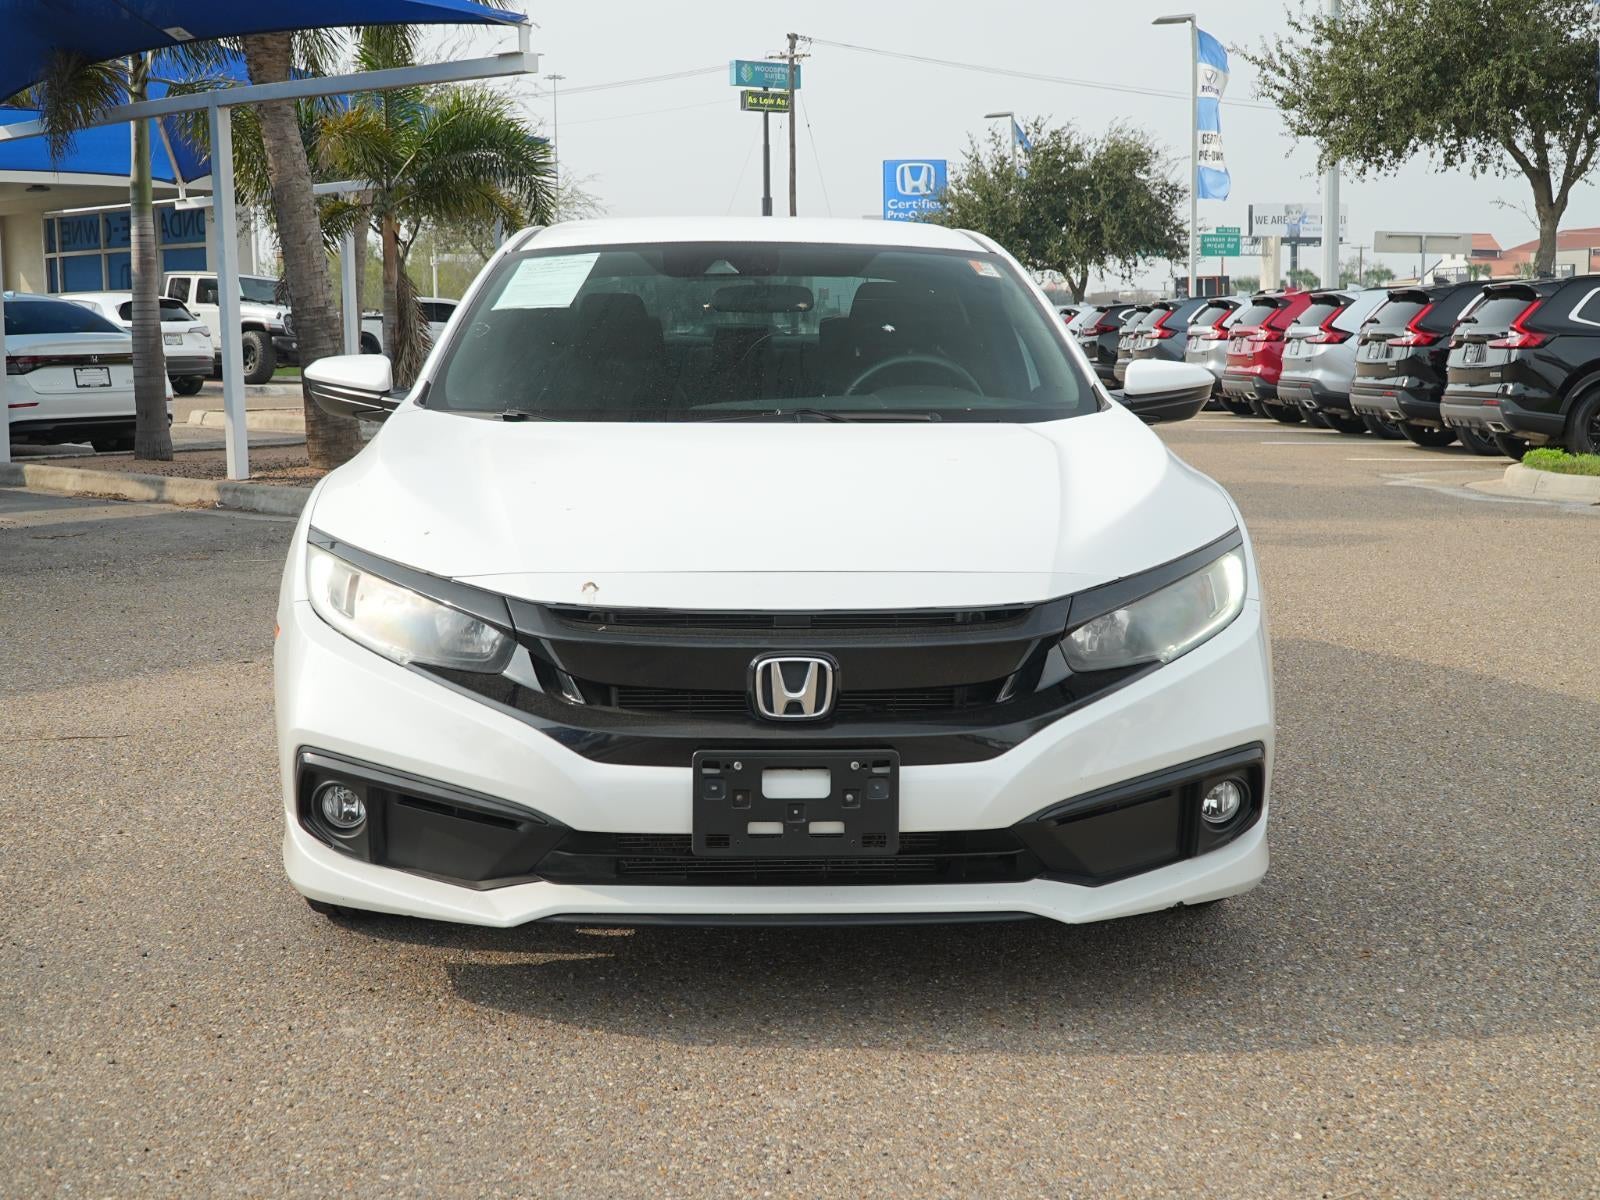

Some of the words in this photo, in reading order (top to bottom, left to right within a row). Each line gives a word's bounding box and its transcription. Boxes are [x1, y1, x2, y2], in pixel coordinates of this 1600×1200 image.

[748, 95, 758, 104] As
[760, 96, 774, 105] Low
[776, 98, 786, 106] As
[1255, 215, 1269, 225] WE
[1271, 215, 1288, 225] ARE
